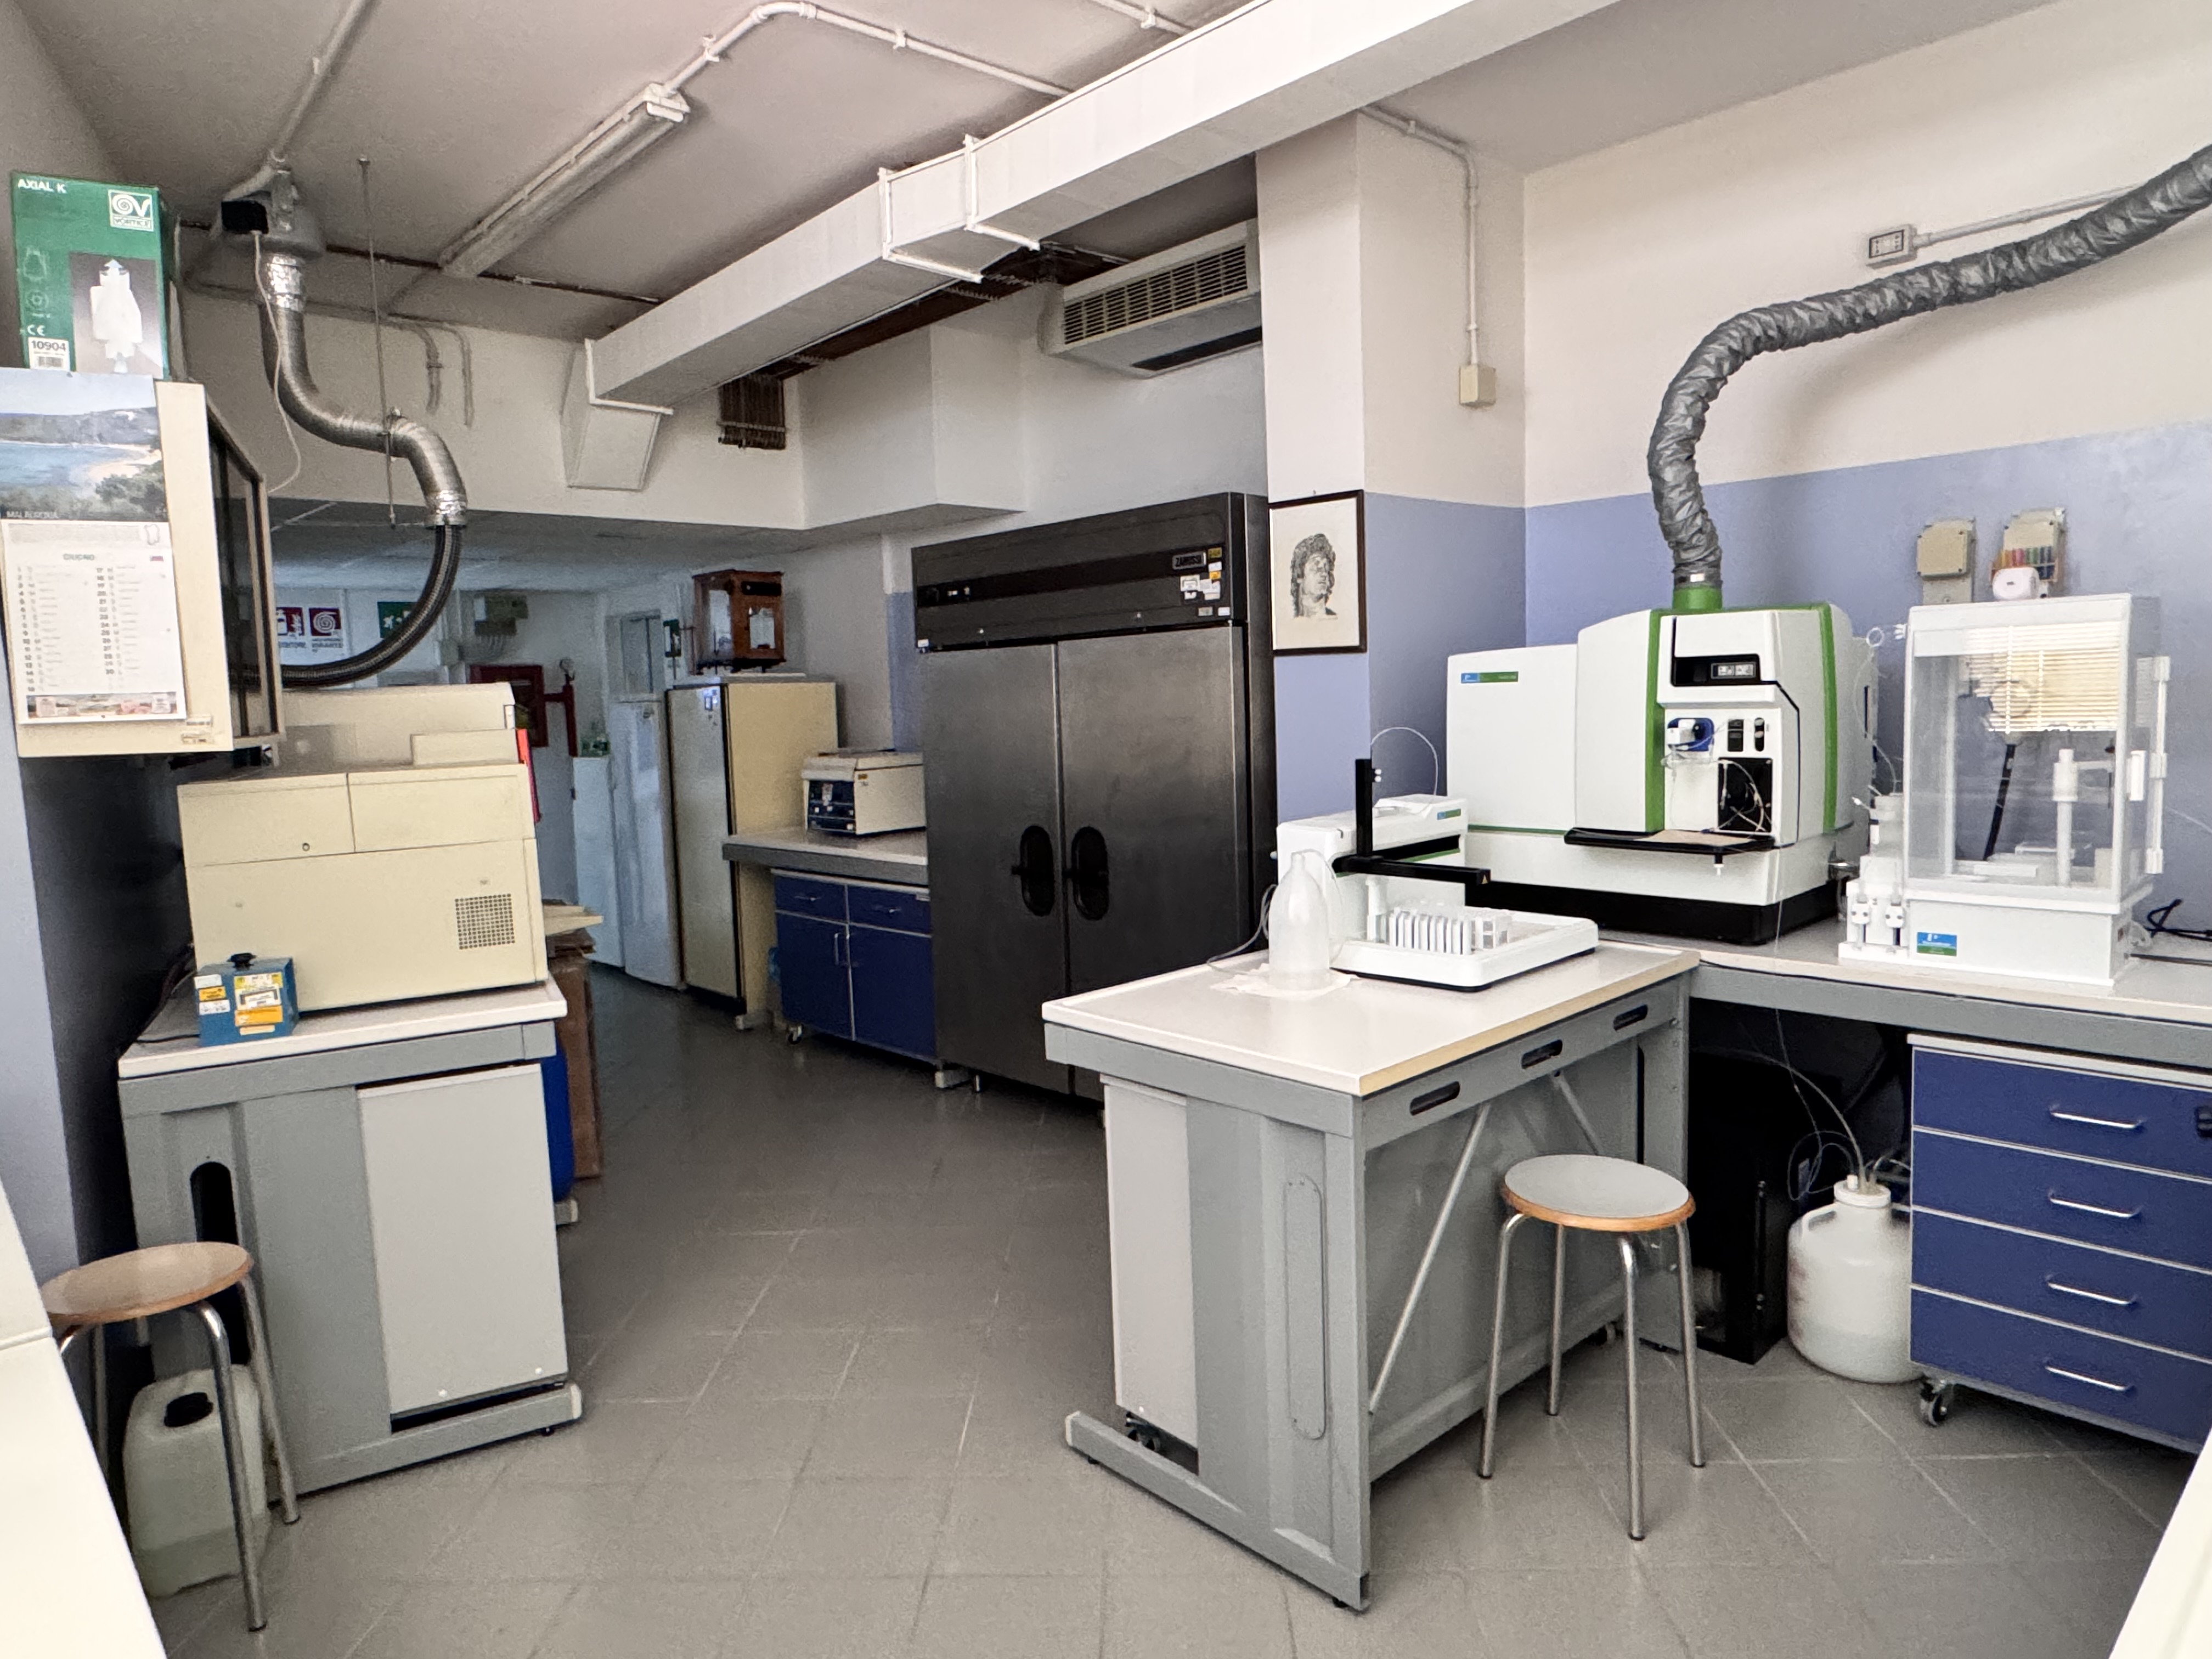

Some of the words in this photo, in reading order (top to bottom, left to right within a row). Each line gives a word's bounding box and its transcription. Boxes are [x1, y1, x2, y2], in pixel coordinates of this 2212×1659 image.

[18, 179, 54, 192] AXIAL
[57, 182, 67, 194] K
[31, 340, 66, 352] 10904
